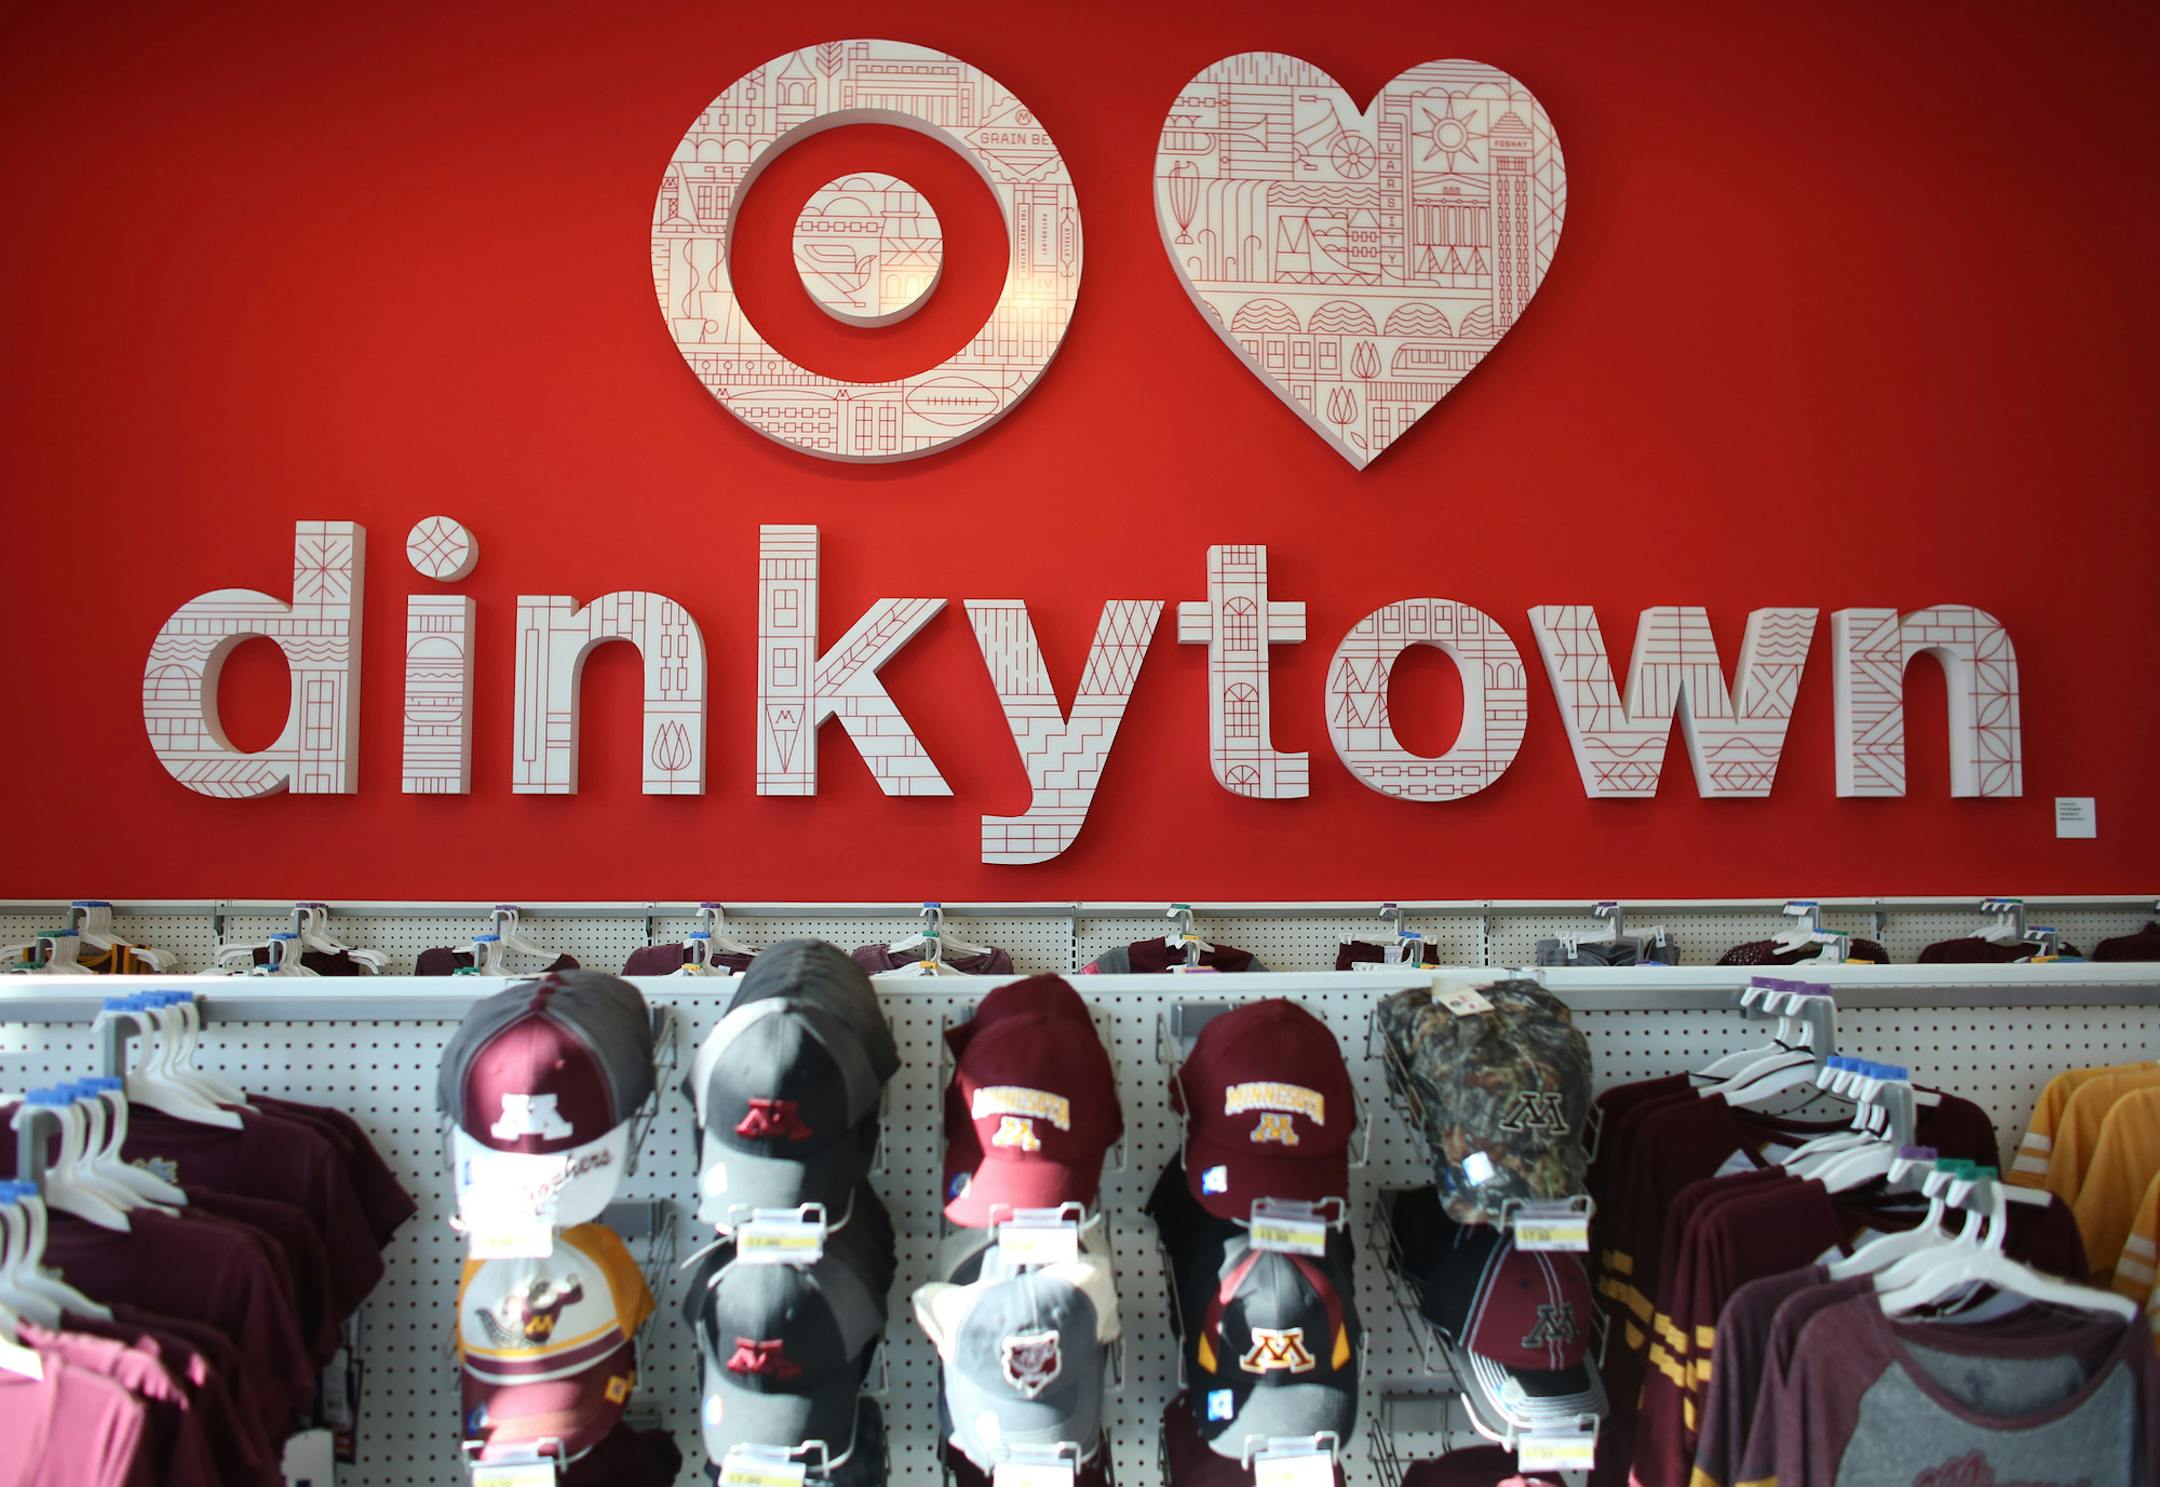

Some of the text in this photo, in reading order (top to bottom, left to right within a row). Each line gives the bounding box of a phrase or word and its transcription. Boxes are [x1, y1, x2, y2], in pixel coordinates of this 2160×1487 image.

[981, 133, 1055, 145] GRAIN BE
[1385, 143, 1396, 263] VARSITY
[142, 515, 2024, 866] dinkytown
[991, 1115, 1041, 1152] M
[1250, 1112, 1299, 1146] M
[1498, 1090, 1570, 1135] M
[1521, 1303, 1578, 1349] M
[1239, 1327, 1316, 1375] M
